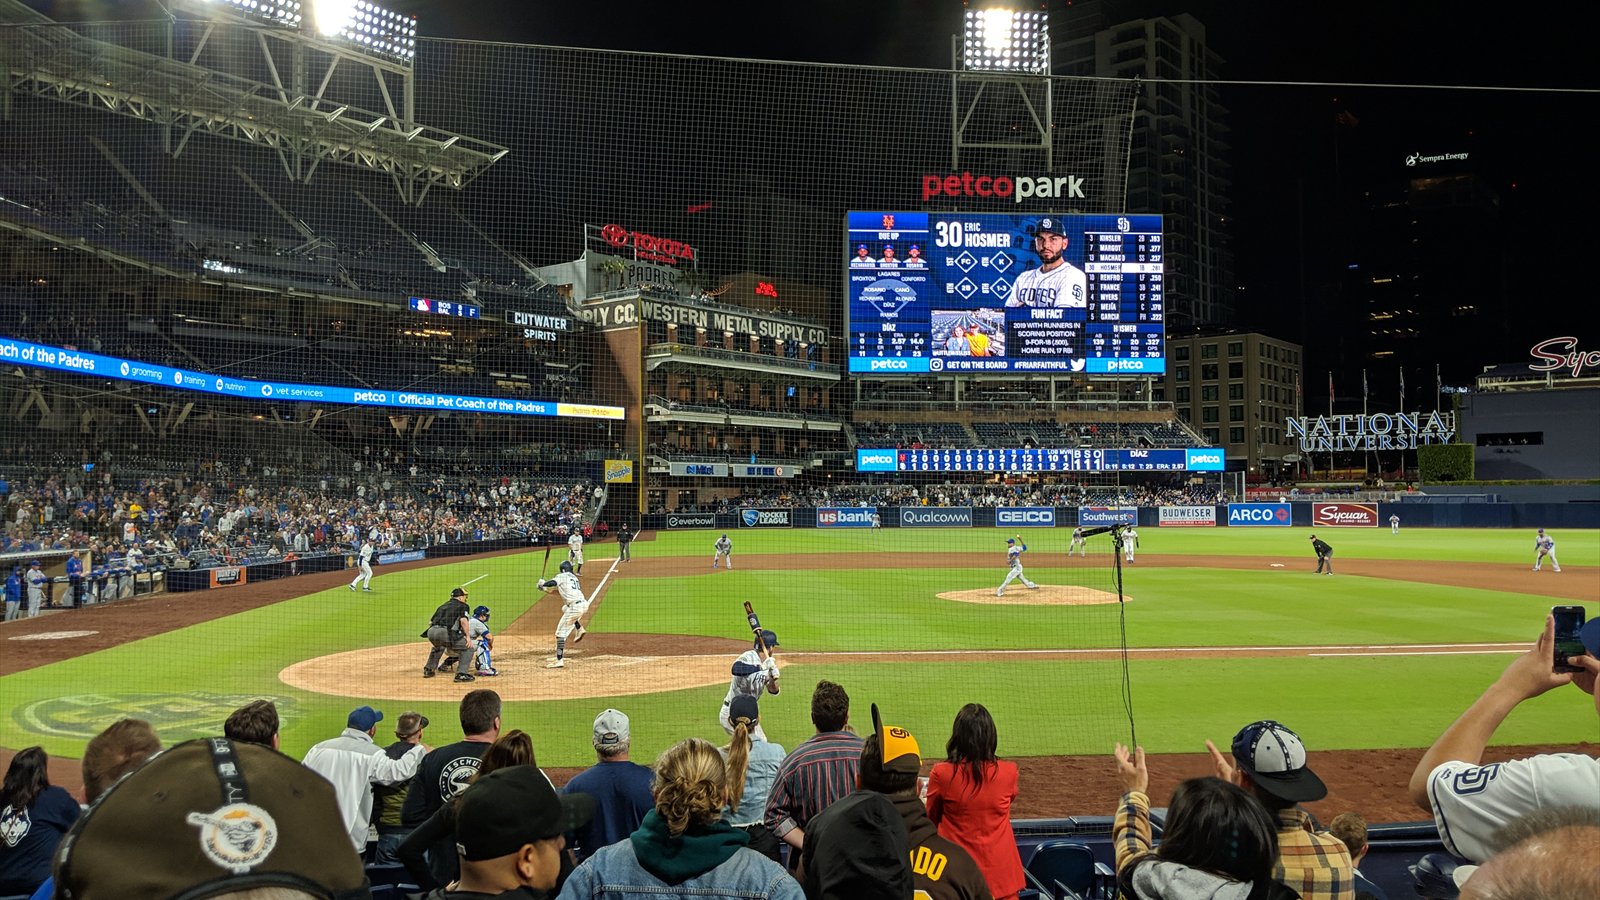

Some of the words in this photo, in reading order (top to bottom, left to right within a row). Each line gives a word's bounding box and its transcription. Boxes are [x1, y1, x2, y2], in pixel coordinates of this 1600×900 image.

[1445, 152, 1469, 160] Energy
[965, 222, 980, 231] ERIC
[878, 232, 890, 240] DUE
[891, 232, 899, 240] UP
[935, 222, 962, 247] 30
[630, 231, 693, 261] TOYOTA
[965, 234, 1010, 248] HOSMER
[629, 264, 675, 285] PADRES
[469, 308, 475, 316] F
[614, 304, 638, 324] CO.
[1031, 309, 1044, 318] FUN
[1046, 309, 1063, 318] FACT
[515, 312, 566, 330] CUTWATER
[640, 301, 707, 326] WESTERN
[714, 314, 756, 335] METAL
[759, 320, 804, 341] SUPPLY
[808, 329, 828, 345] CO.
[882, 323, 896, 331] DÍAZ
[524, 329, 557, 342] SPIRITS
[22, 346, 34, 360] of
[37, 348, 55, 364] the
[59, 352, 95, 370] Padres
[871, 359, 907, 371] petco
[947, 361, 960, 369] GET
[961, 361, 971, 369] ON
[972, 361, 984, 369] THE
[985, 361, 1008, 369] BOARD
[1014, 361, 1068, 369] #FRIARFAITHFUL
[1107, 360, 1143, 372] petco
[132, 367, 162, 381] grooming
[184, 374, 206, 387] training
[225, 382, 246, 391] nutrition
[276, 387, 289, 395] vet
[291, 388, 323, 397] services
[354, 391, 386, 404] petco
[398, 394, 434, 406] Official
[437, 396, 453, 407] Pet
[456, 398, 485, 409] Coach
[487, 400, 497, 410] of
[499, 400, 513, 411] the
[516, 402, 545, 413] Padres
[1299, 432, 1454, 452] UNIVERSITY
[1074, 450, 1081, 458] B
[1084, 450, 1091, 458] S
[1094, 450, 1101, 458] O
[1130, 449, 1148, 458] DÍAZ
[1190, 454, 1220, 465] petco
[862, 455, 893, 465] petco
[1074, 459, 1080, 470] 1
[1084, 459, 1090, 470] 1
[1094, 459, 1100, 470] 1
[607, 466, 631, 480] Snapple
[904, 511, 970, 524] Qualcomm
[999, 511, 1052, 522] GEICO
[1083, 512, 1128, 521] Southwest
[1163, 509, 1211, 517] BUDWEISER
[1230, 509, 1273, 521] ARCO
[1320, 506, 1368, 523] Sycuan
[678, 517, 713, 526] everbowl
[910, 846, 947, 882] DO
